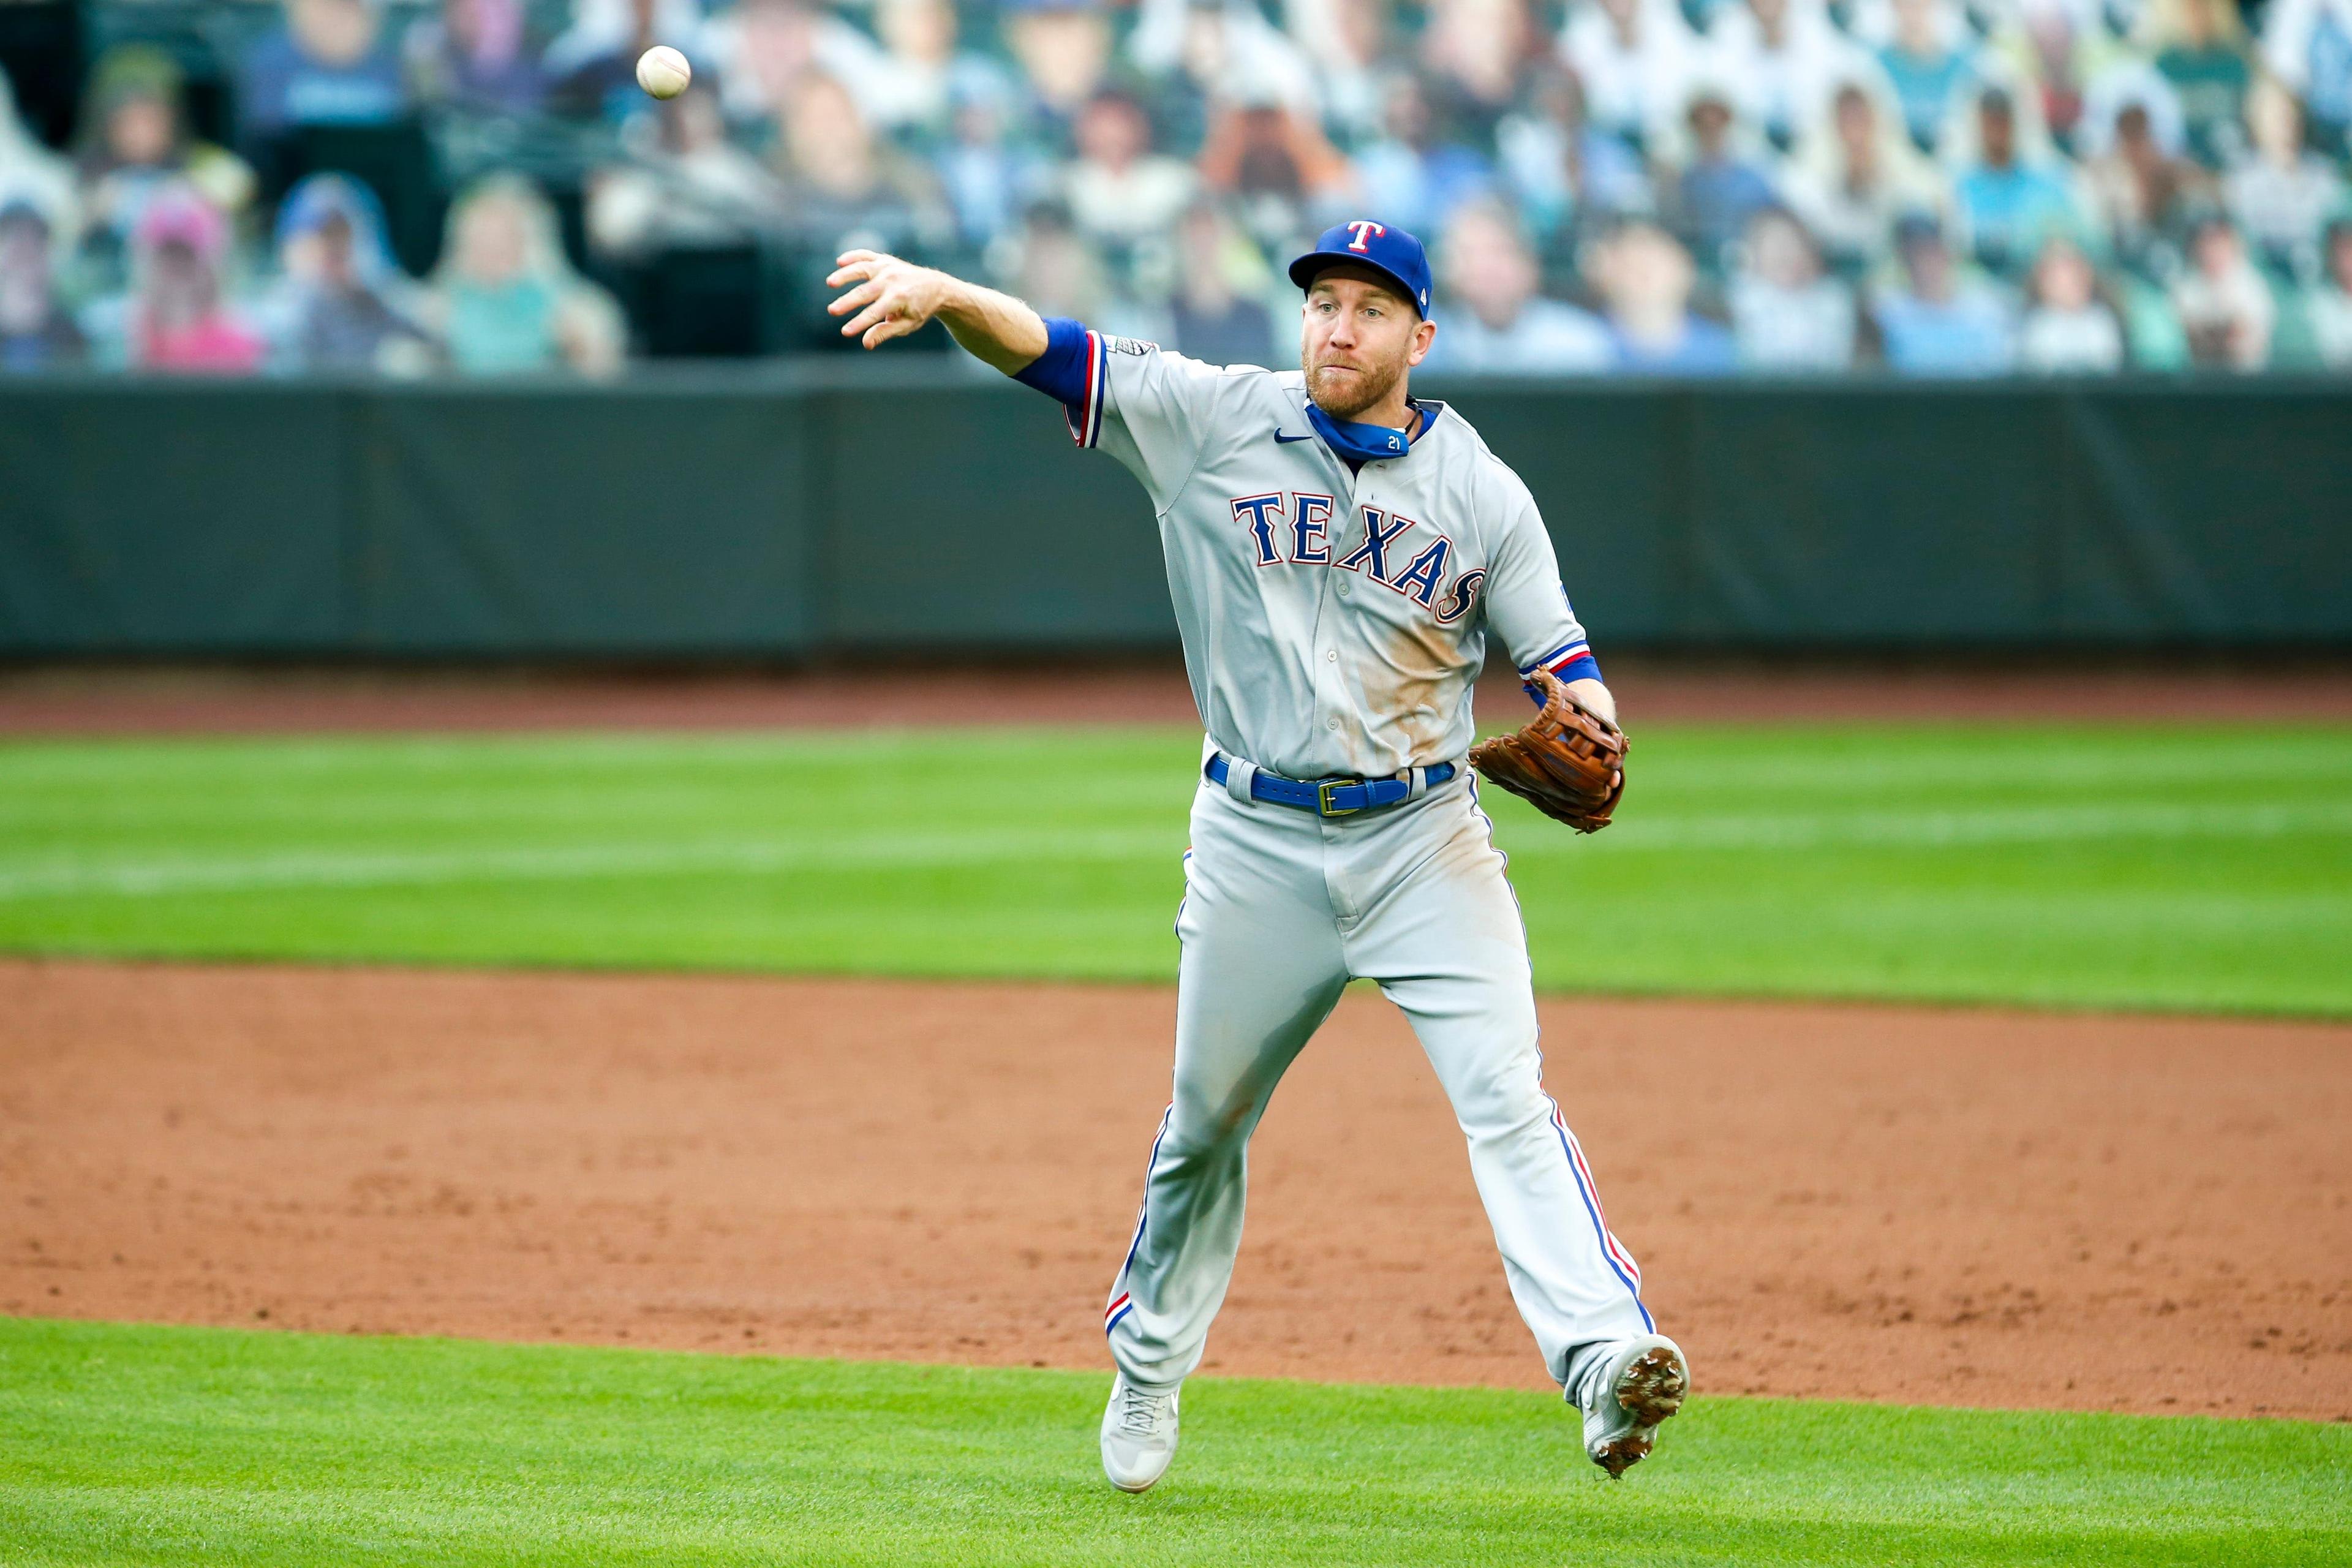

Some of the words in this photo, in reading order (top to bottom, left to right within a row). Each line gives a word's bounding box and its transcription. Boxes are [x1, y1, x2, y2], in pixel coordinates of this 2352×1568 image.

[1348, 221, 1386, 253] T
[1389, 435, 1400, 450] 21
[1230, 492, 1486, 624] TEXAS
